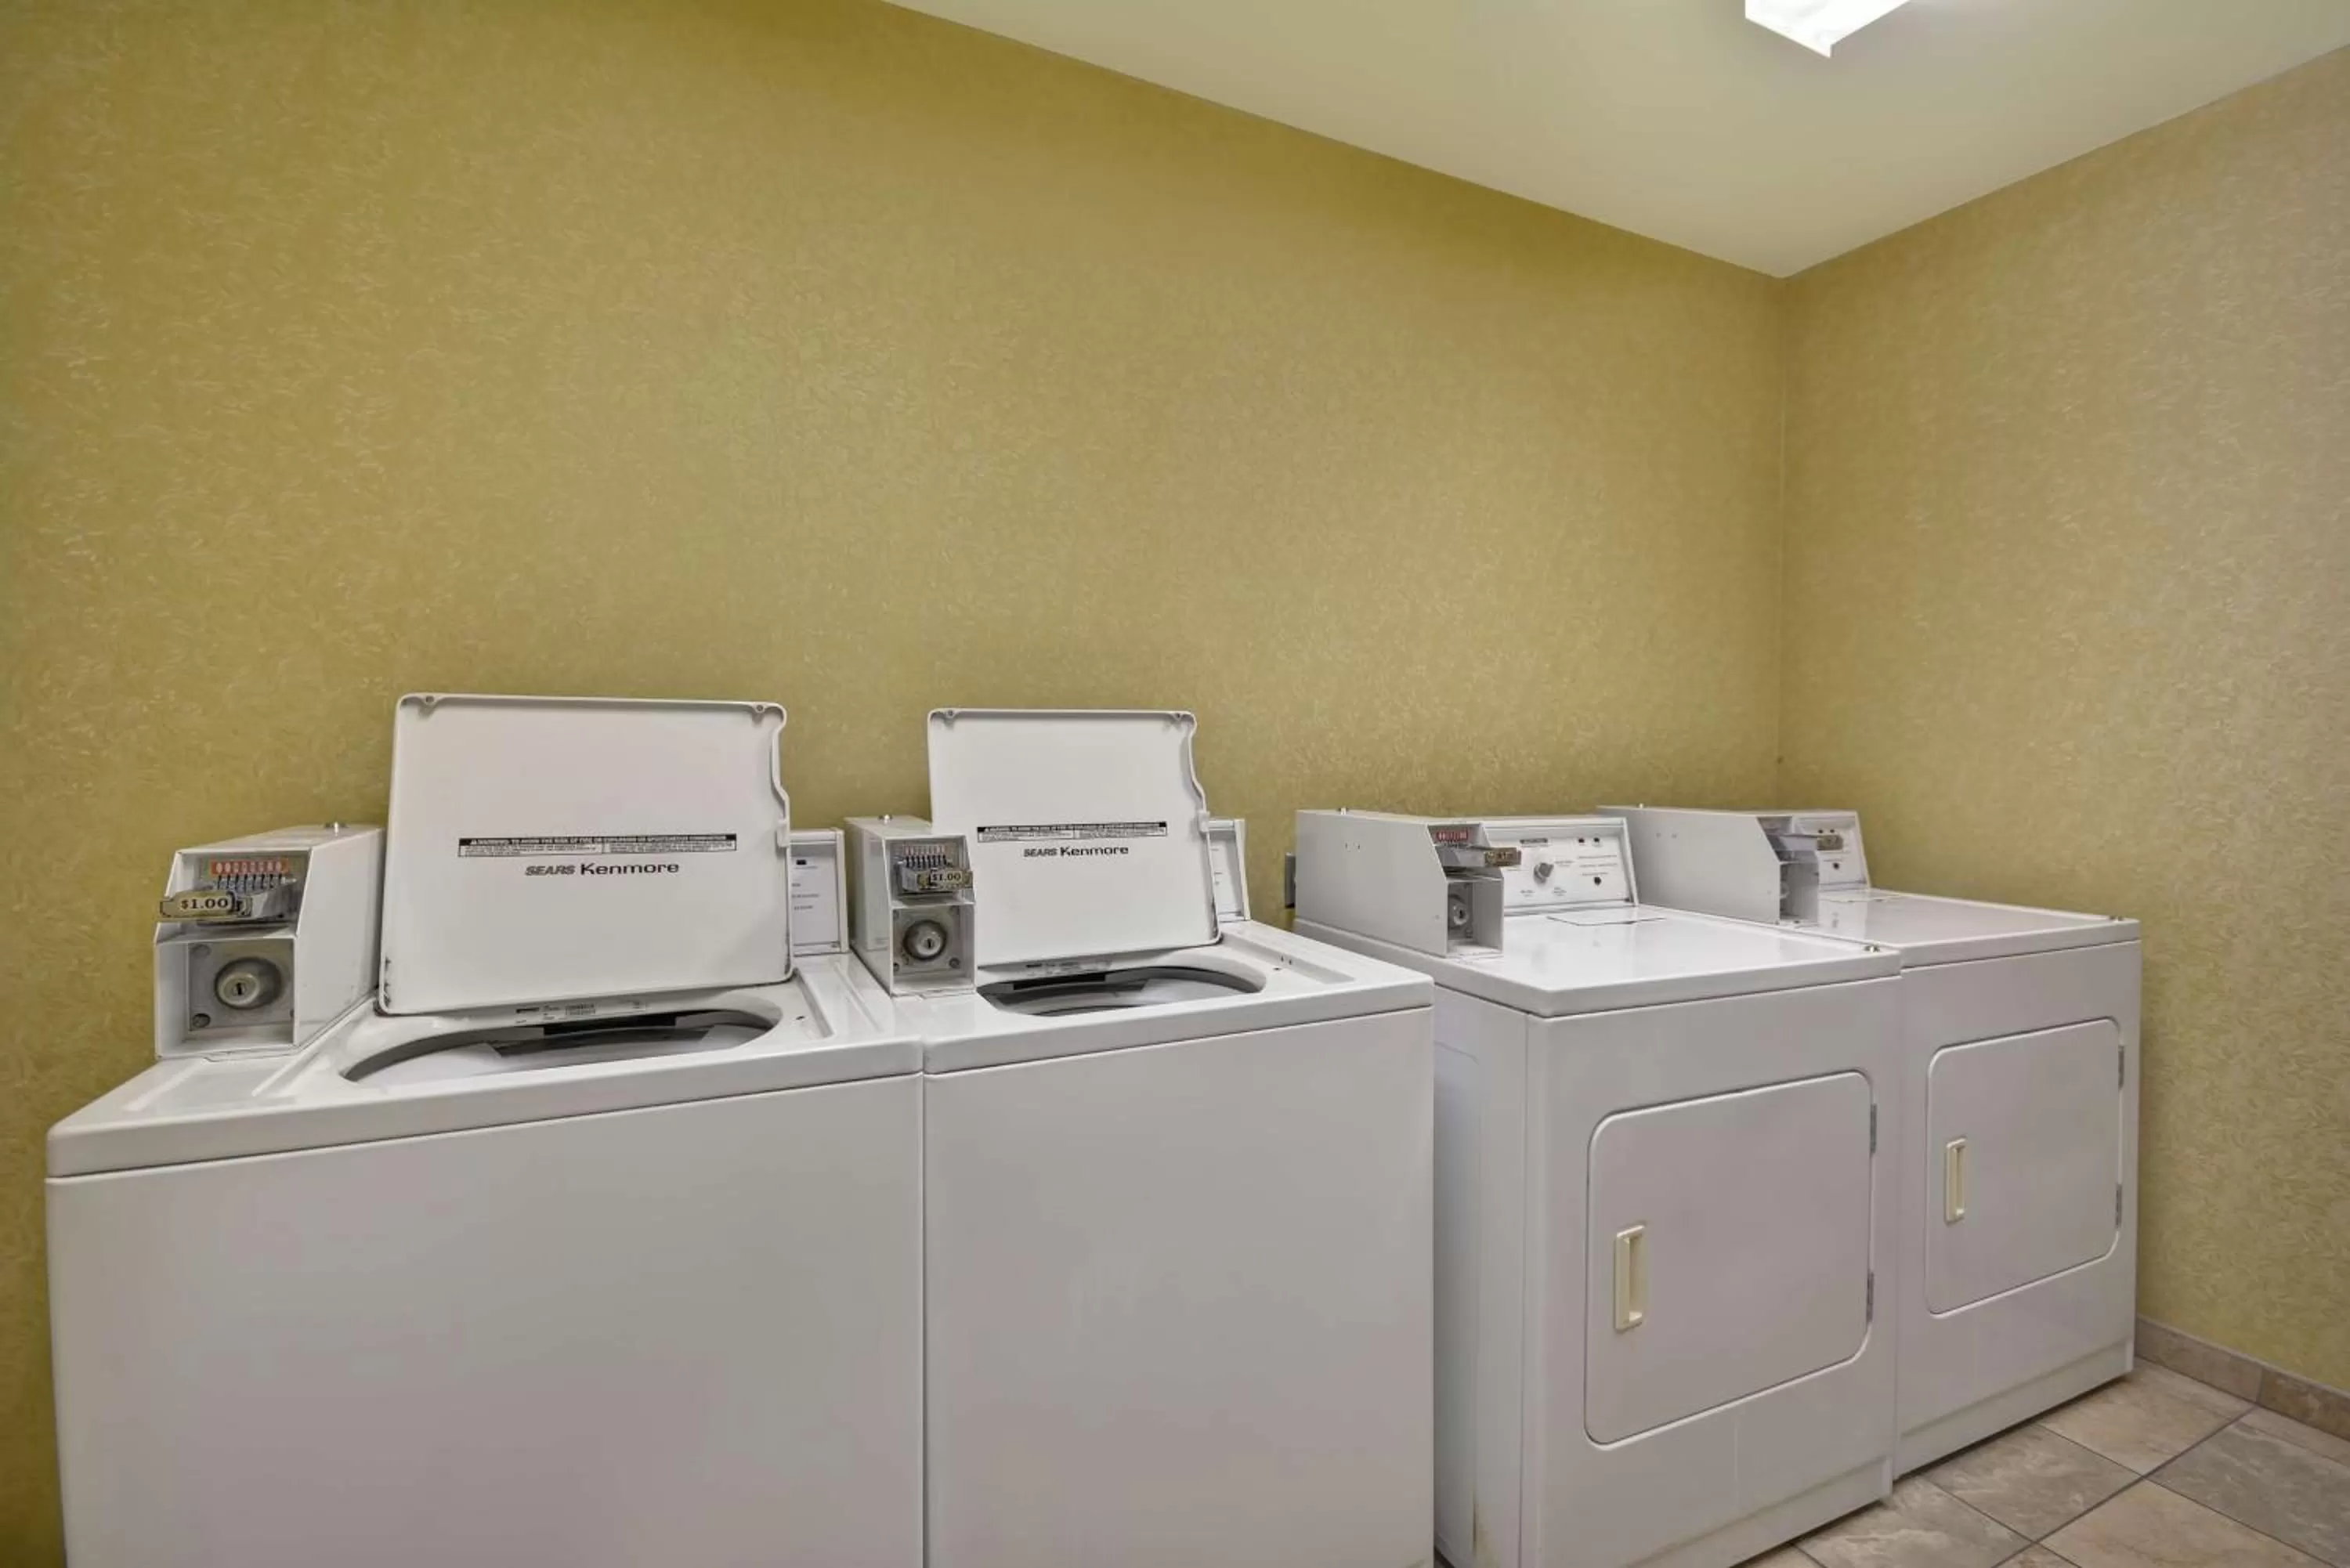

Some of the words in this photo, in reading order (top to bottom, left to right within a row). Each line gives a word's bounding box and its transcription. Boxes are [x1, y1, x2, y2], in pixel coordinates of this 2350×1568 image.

[1024, 847, 1058, 858] SEARS
[1060, 846, 1129, 857] Kenmore
[525, 864, 575, 876] SEARS
[580, 862, 679, 876] Kenmore
[180, 898, 229, 910] $1.00
